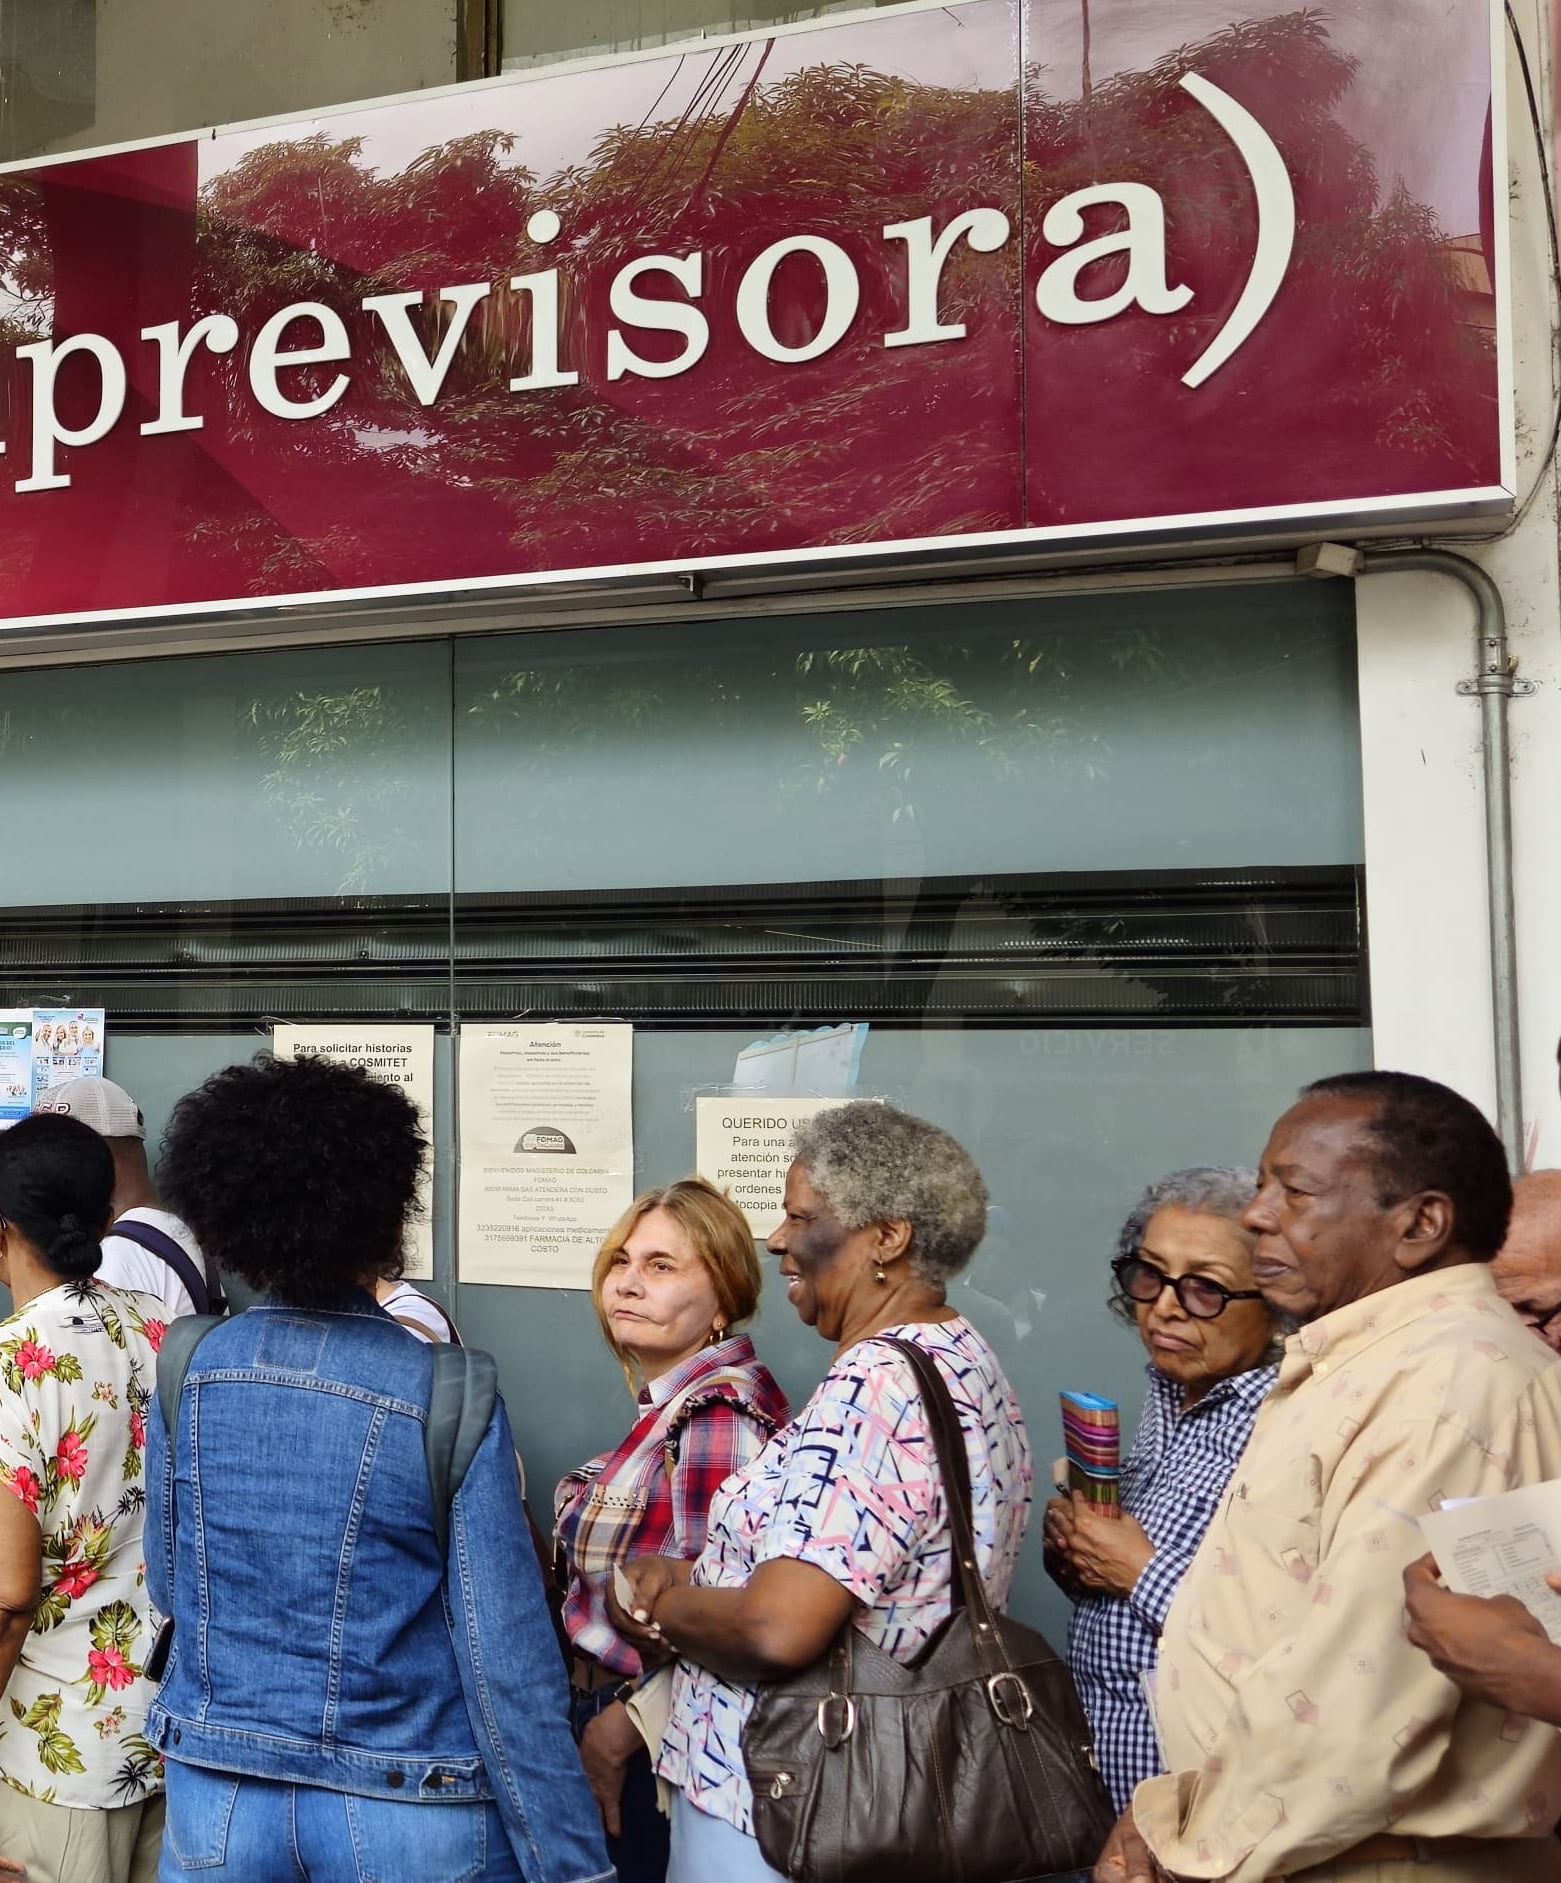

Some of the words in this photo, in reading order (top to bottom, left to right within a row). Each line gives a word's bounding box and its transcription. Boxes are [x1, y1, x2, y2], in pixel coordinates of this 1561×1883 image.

[293, 1043, 317, 1053] Para
[319, 1043, 363, 1053] solicitar
[365, 1043, 413, 1053] historias
[529, 1040, 562, 1048] Atención
[349, 1057, 408, 1068] COSMITET
[403, 1072, 413, 1082] al
[722, 1117, 788, 1129] QUERIDO
[732, 1136, 760, 1147] Para
[763, 1138, 785, 1147] una
[730, 1152, 780, 1163] atención
[717, 1168, 772, 1179] presentar
[735, 1183, 782, 1194] ordenes
[529, 1235, 570, 1243] FARMACIA
[572, 1236, 584, 1244] DE
[530, 1245, 560, 1253] COSTO
